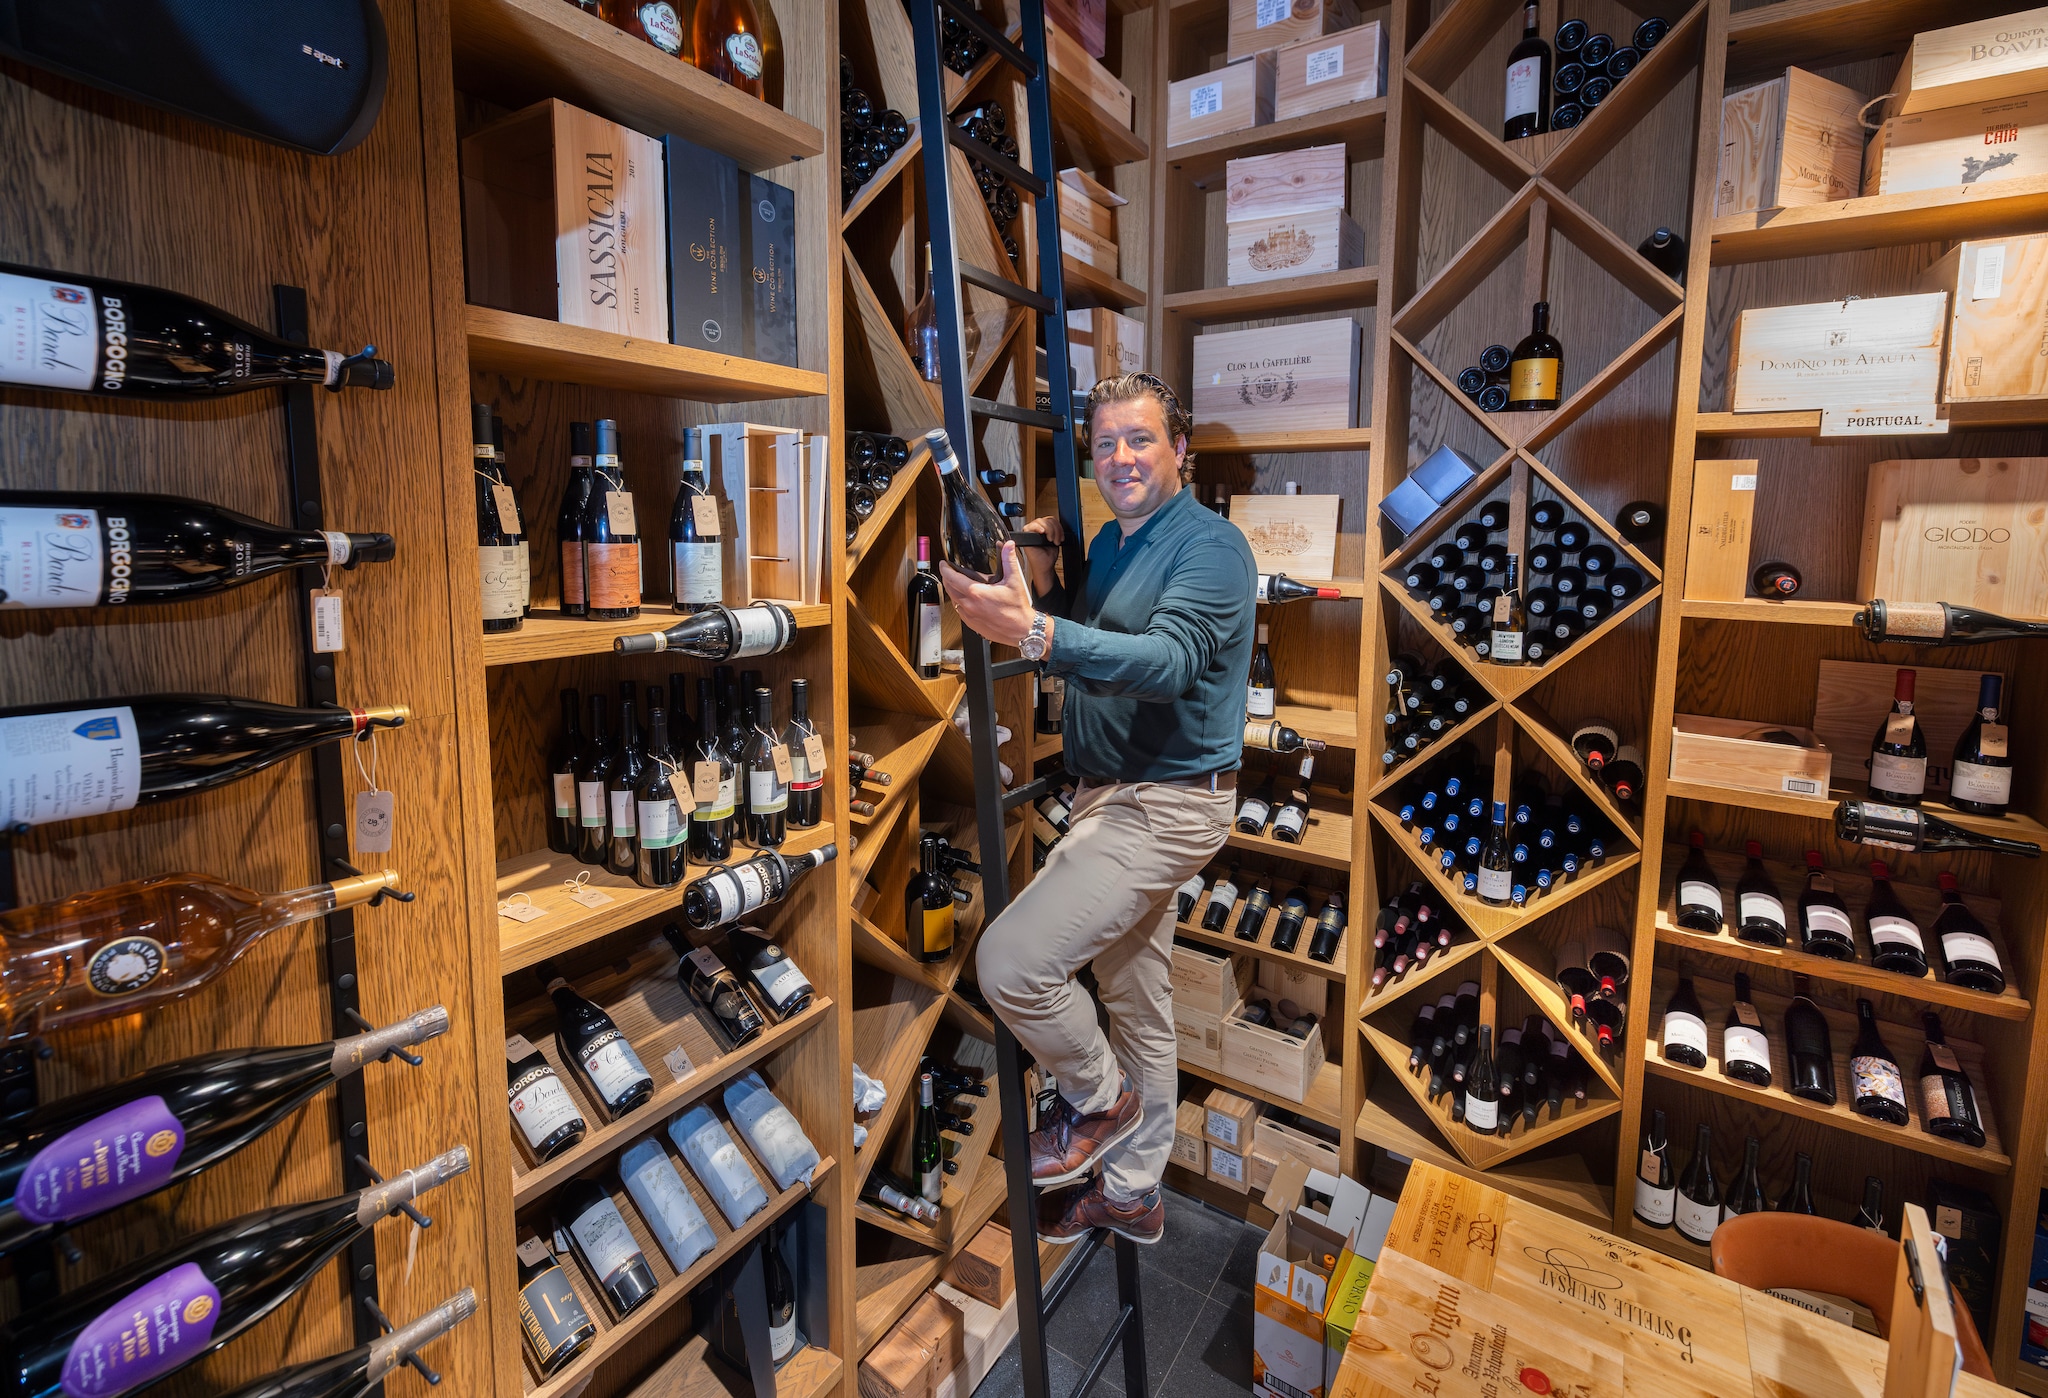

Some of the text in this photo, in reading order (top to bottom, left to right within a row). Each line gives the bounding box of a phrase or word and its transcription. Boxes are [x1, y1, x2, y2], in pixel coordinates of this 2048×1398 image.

[650, 17, 680, 40] La Scolca
[1995, 28, 2045, 43] QUINTA
[314, 49, 345, 69] apart
[743, 50, 761, 67] Scolca
[1984, 128, 2018, 145] CAIR
[1799, 166, 1844, 188] Monte d'Oiro
[586, 151, 617, 309] SASSICAIA
[619, 210, 627, 254] BOLGHERI
[102, 296, 128, 390] BORGOGNO
[234, 343, 244, 378] 2010
[1227, 355, 1312, 372] CLOS LA GAFFELIÈRE
[1761, 354, 1917, 371] DOMINIO DE ATAUTA
[1847, 416, 1922, 427] PORTUGAL
[1924, 527, 2011, 544] GIODO
[107, 517, 131, 604] BORGOGNO
[235, 543, 244, 577] 2010
[753, 862, 771, 902] BORGOG
[91, 948, 118, 992] PROVENCE
[127, 942, 159, 988] MIRAVAL
[582, 1030, 623, 1058] BORGOG
[508, 1066, 555, 1098] BORGOGN
[80, 1163, 96, 1190] FILS
[94, 1145, 110, 1186] FOURNY
[1429, 1181, 1461, 1259] D'ESCURAC
[1618, 1243, 1642, 1257] Nino
[1343, 1271, 1369, 1314] BORSAO
[1764, 1288, 1831, 1318] PORTUGAL
[1539, 1268, 1694, 1364] 5 STELLE SFURSAT
[1410, 1279, 1462, 1398] Le Origini
[1462, 1331, 1487, 1380] Amarone
[1482, 1324, 1509, 1382] Valpolicella
